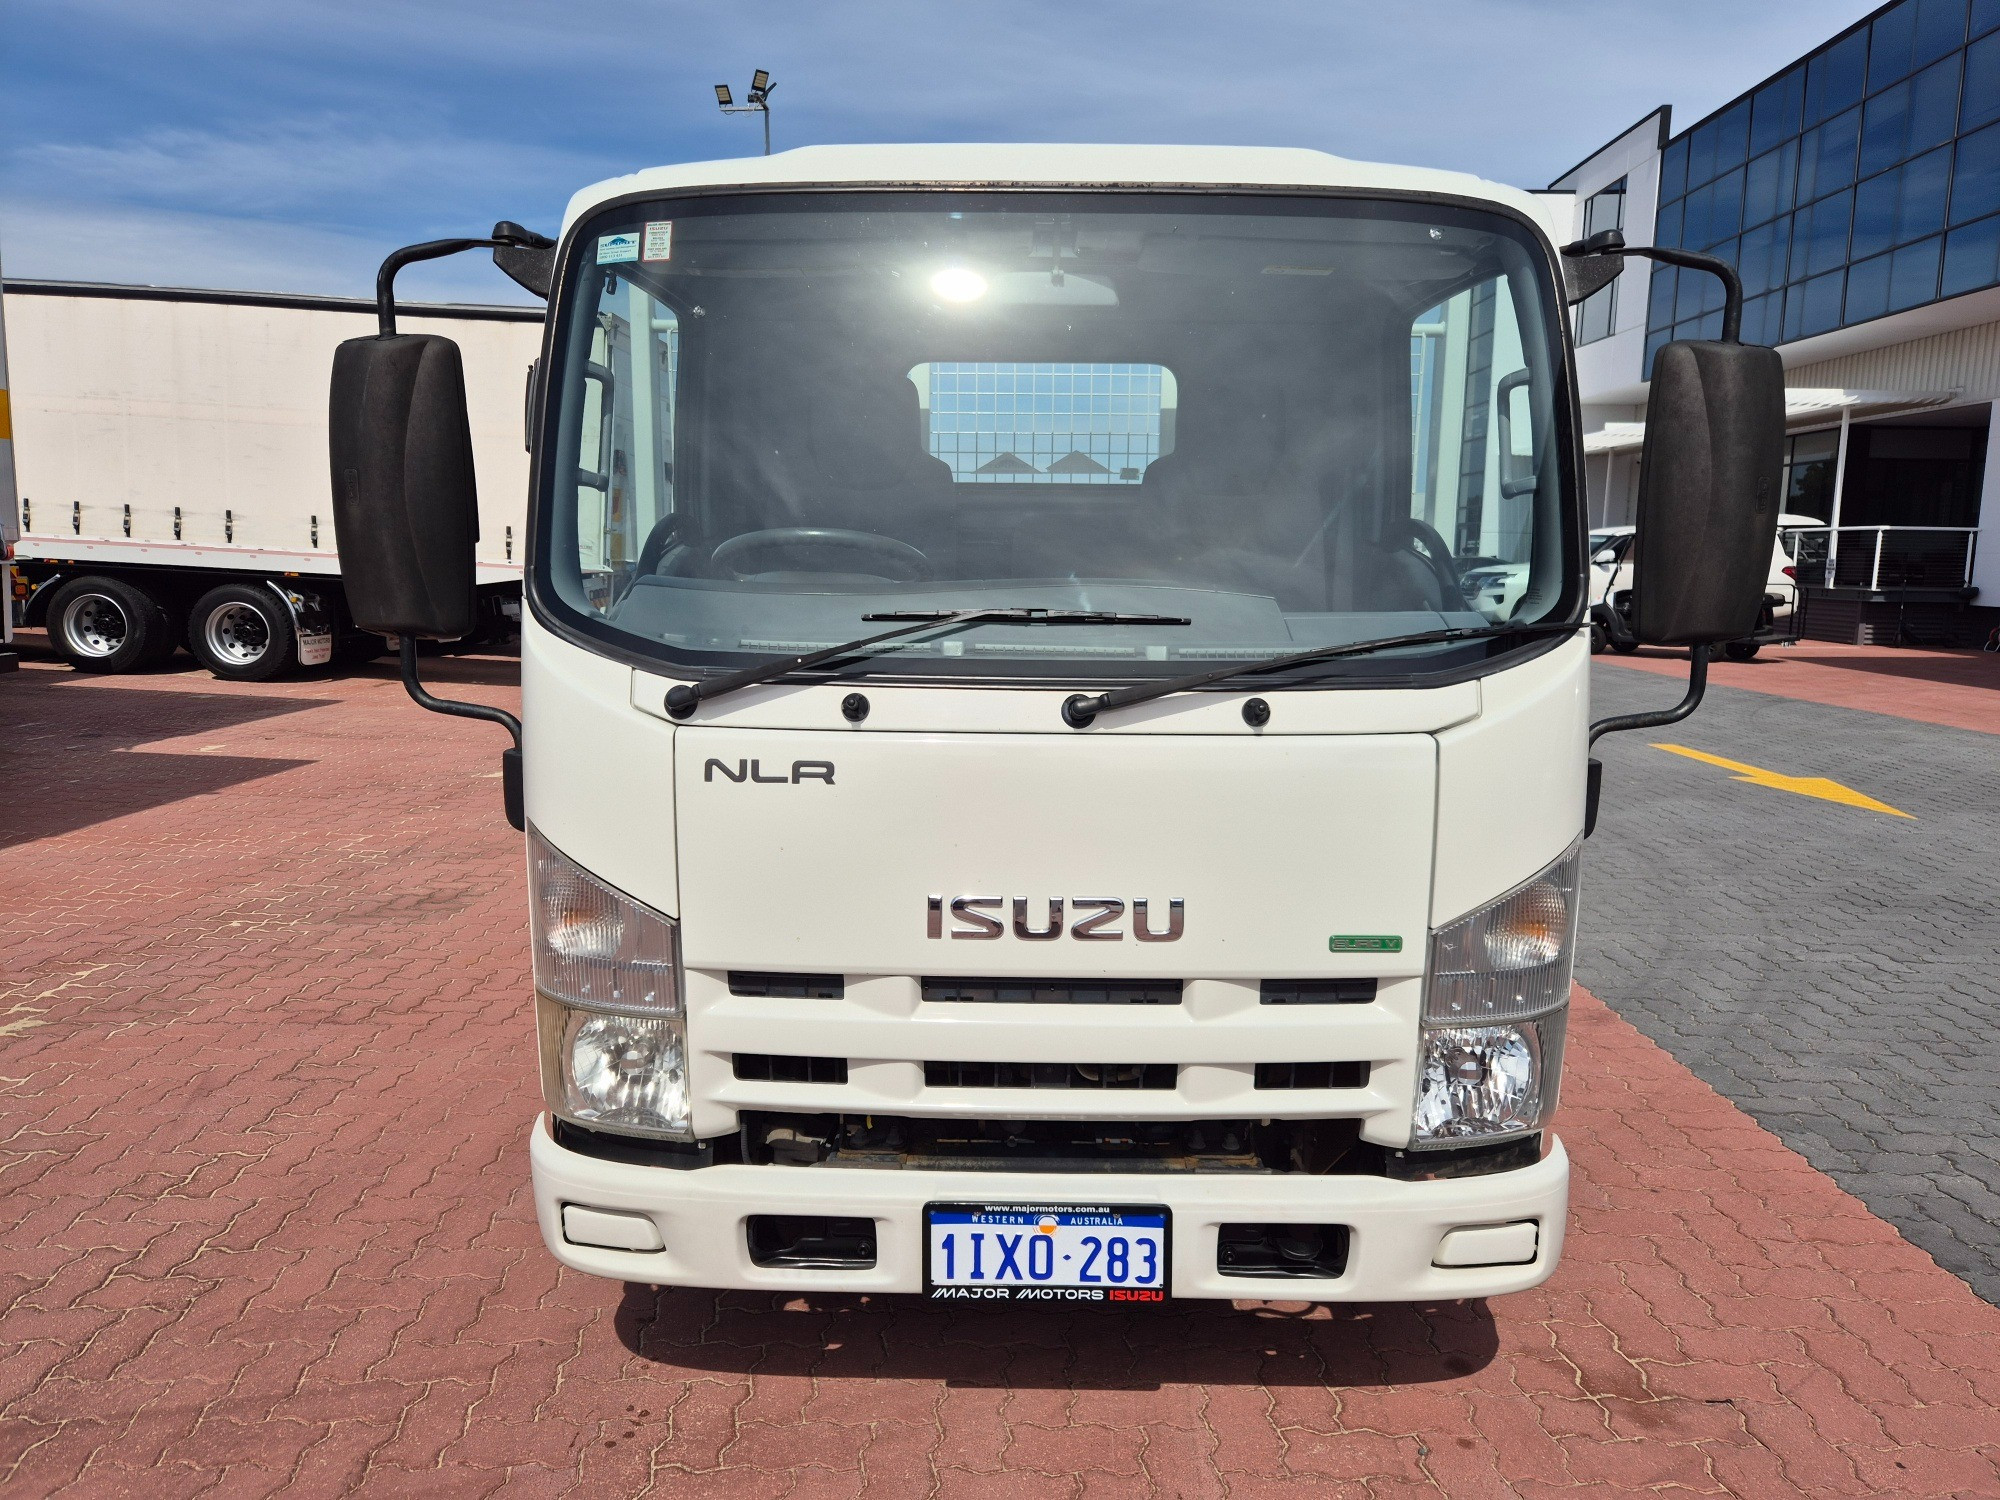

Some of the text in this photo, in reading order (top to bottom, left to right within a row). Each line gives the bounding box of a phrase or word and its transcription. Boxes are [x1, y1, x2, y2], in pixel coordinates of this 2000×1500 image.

[703, 757, 836, 785] NLR
[927, 894, 1185, 942] ISUZU
[1333, 939, 1397, 949] EURO V
[985, 1204, 1110, 1214] www.majormotors.com.au
[971, 1214, 1123, 1226] WESTERN AUSTRALIA
[931, 1287, 1164, 1302] MAJOR MOTORS ISUZU
